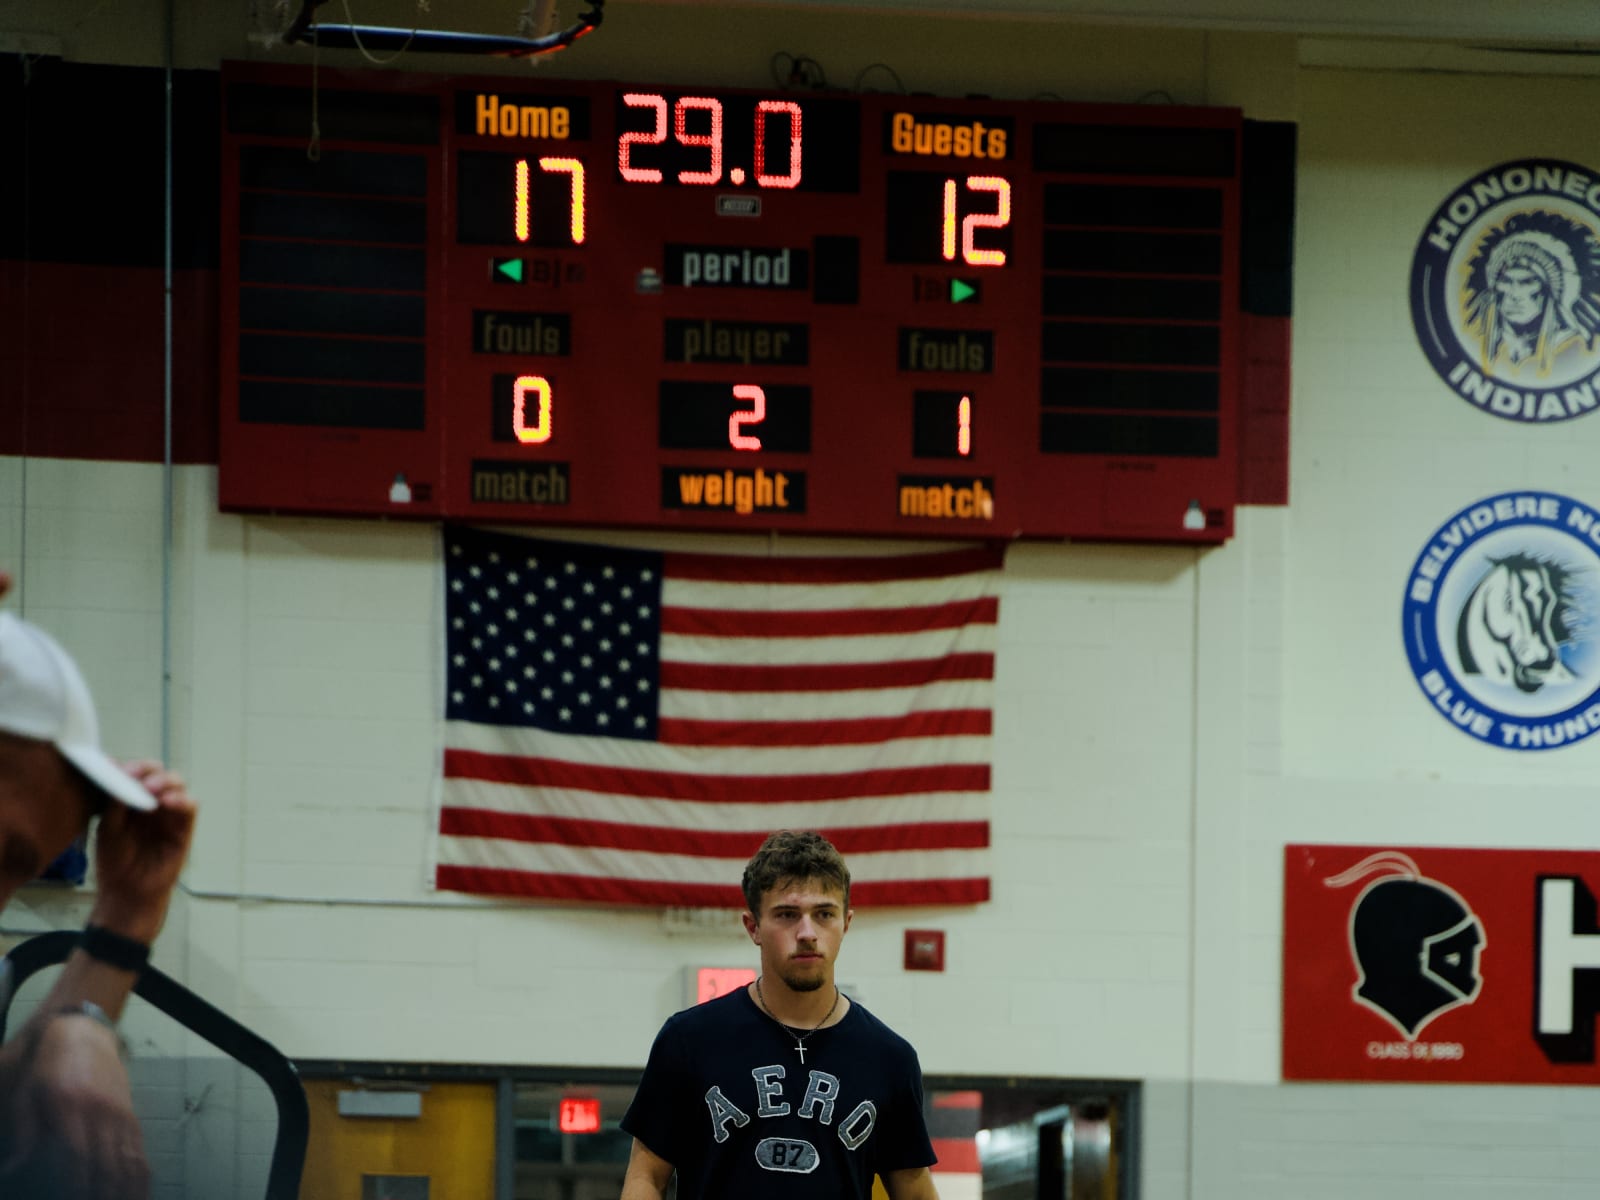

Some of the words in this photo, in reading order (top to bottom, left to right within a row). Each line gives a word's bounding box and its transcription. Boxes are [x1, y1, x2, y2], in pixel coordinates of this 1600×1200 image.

[476, 95, 570, 140] Home
[618, 92, 803, 190] 29.0
[891, 112, 1008, 160] Guests
[514, 157, 587, 244] 17
[941, 176, 1012, 266] 12
[682, 249, 790, 287] period
[482, 313, 560, 354] fouls
[683, 319, 791, 365] player
[907, 331, 985, 372] fouls
[512, 374, 554, 445] 0
[728, 383, 767, 452] 2
[956, 394, 972, 457] 1
[474, 466, 567, 504] match
[679, 467, 790, 515] weight
[899, 479, 995, 520] match
[1410, 495, 1561, 604] BELVIDERE
[1421, 668, 1494, 738] BLUE
[1367, 1040, 1410, 1060] CLASS
[704, 1064, 878, 1152] AERO
[770, 1143, 804, 1168] 87
